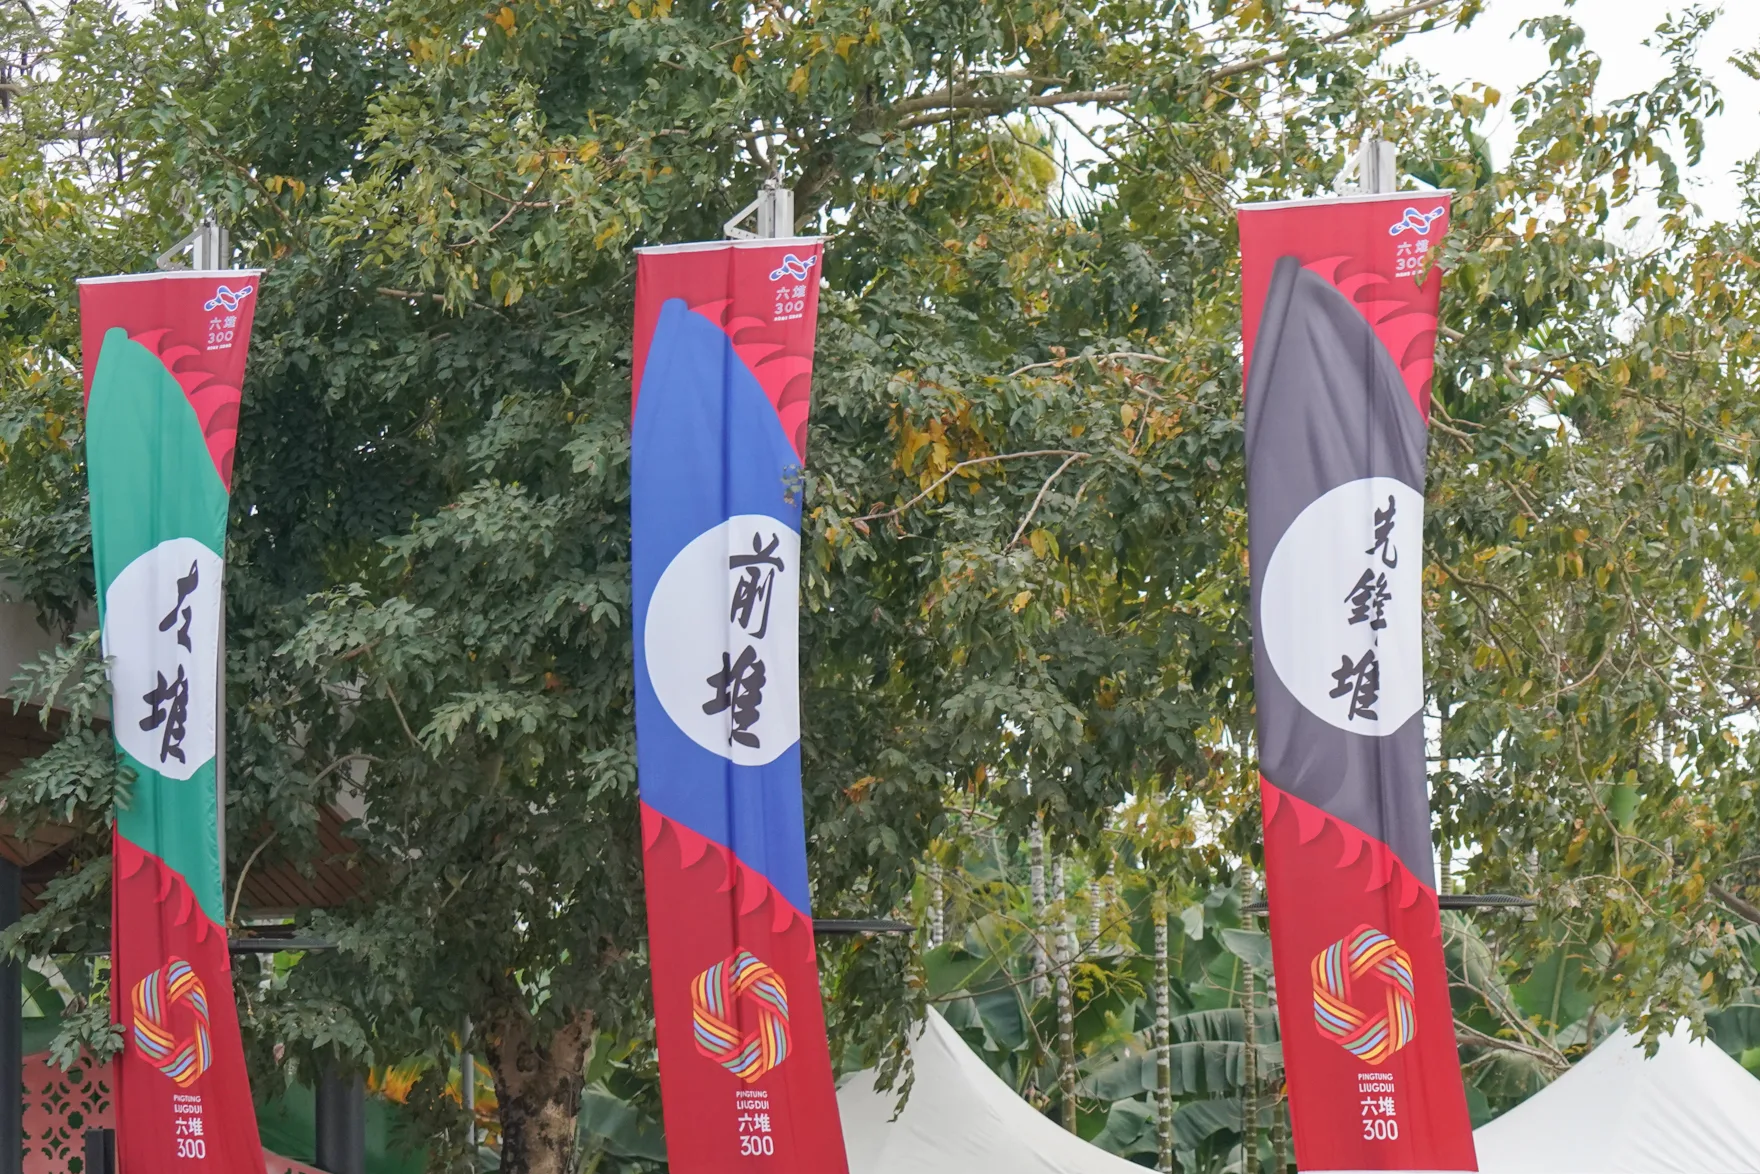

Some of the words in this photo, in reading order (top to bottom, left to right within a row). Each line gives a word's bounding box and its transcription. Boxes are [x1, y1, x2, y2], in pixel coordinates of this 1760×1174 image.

[1397, 239, 1429, 256] 六堆
[776, 285, 806, 300] 六堆
[774, 300, 804, 315] 300
[209, 316, 237, 330] 六堆
[207, 331, 233, 344] 300
[1329, 494, 1398, 721] 先鋒堆
[702, 531, 785, 749] 前堆
[1357, 1073, 1393, 1081] PINGTUNG
[1358, 1083, 1395, 1093] LIUGDUI
[1360, 1096, 1396, 1117] 六堆
[175, 1116, 204, 1137] 六堆
[738, 1113, 772, 1133] 六堆
[1362, 1119, 1399, 1141] 300
[177, 1138, 206, 1159] 300
[740, 1135, 774, 1156] 300
